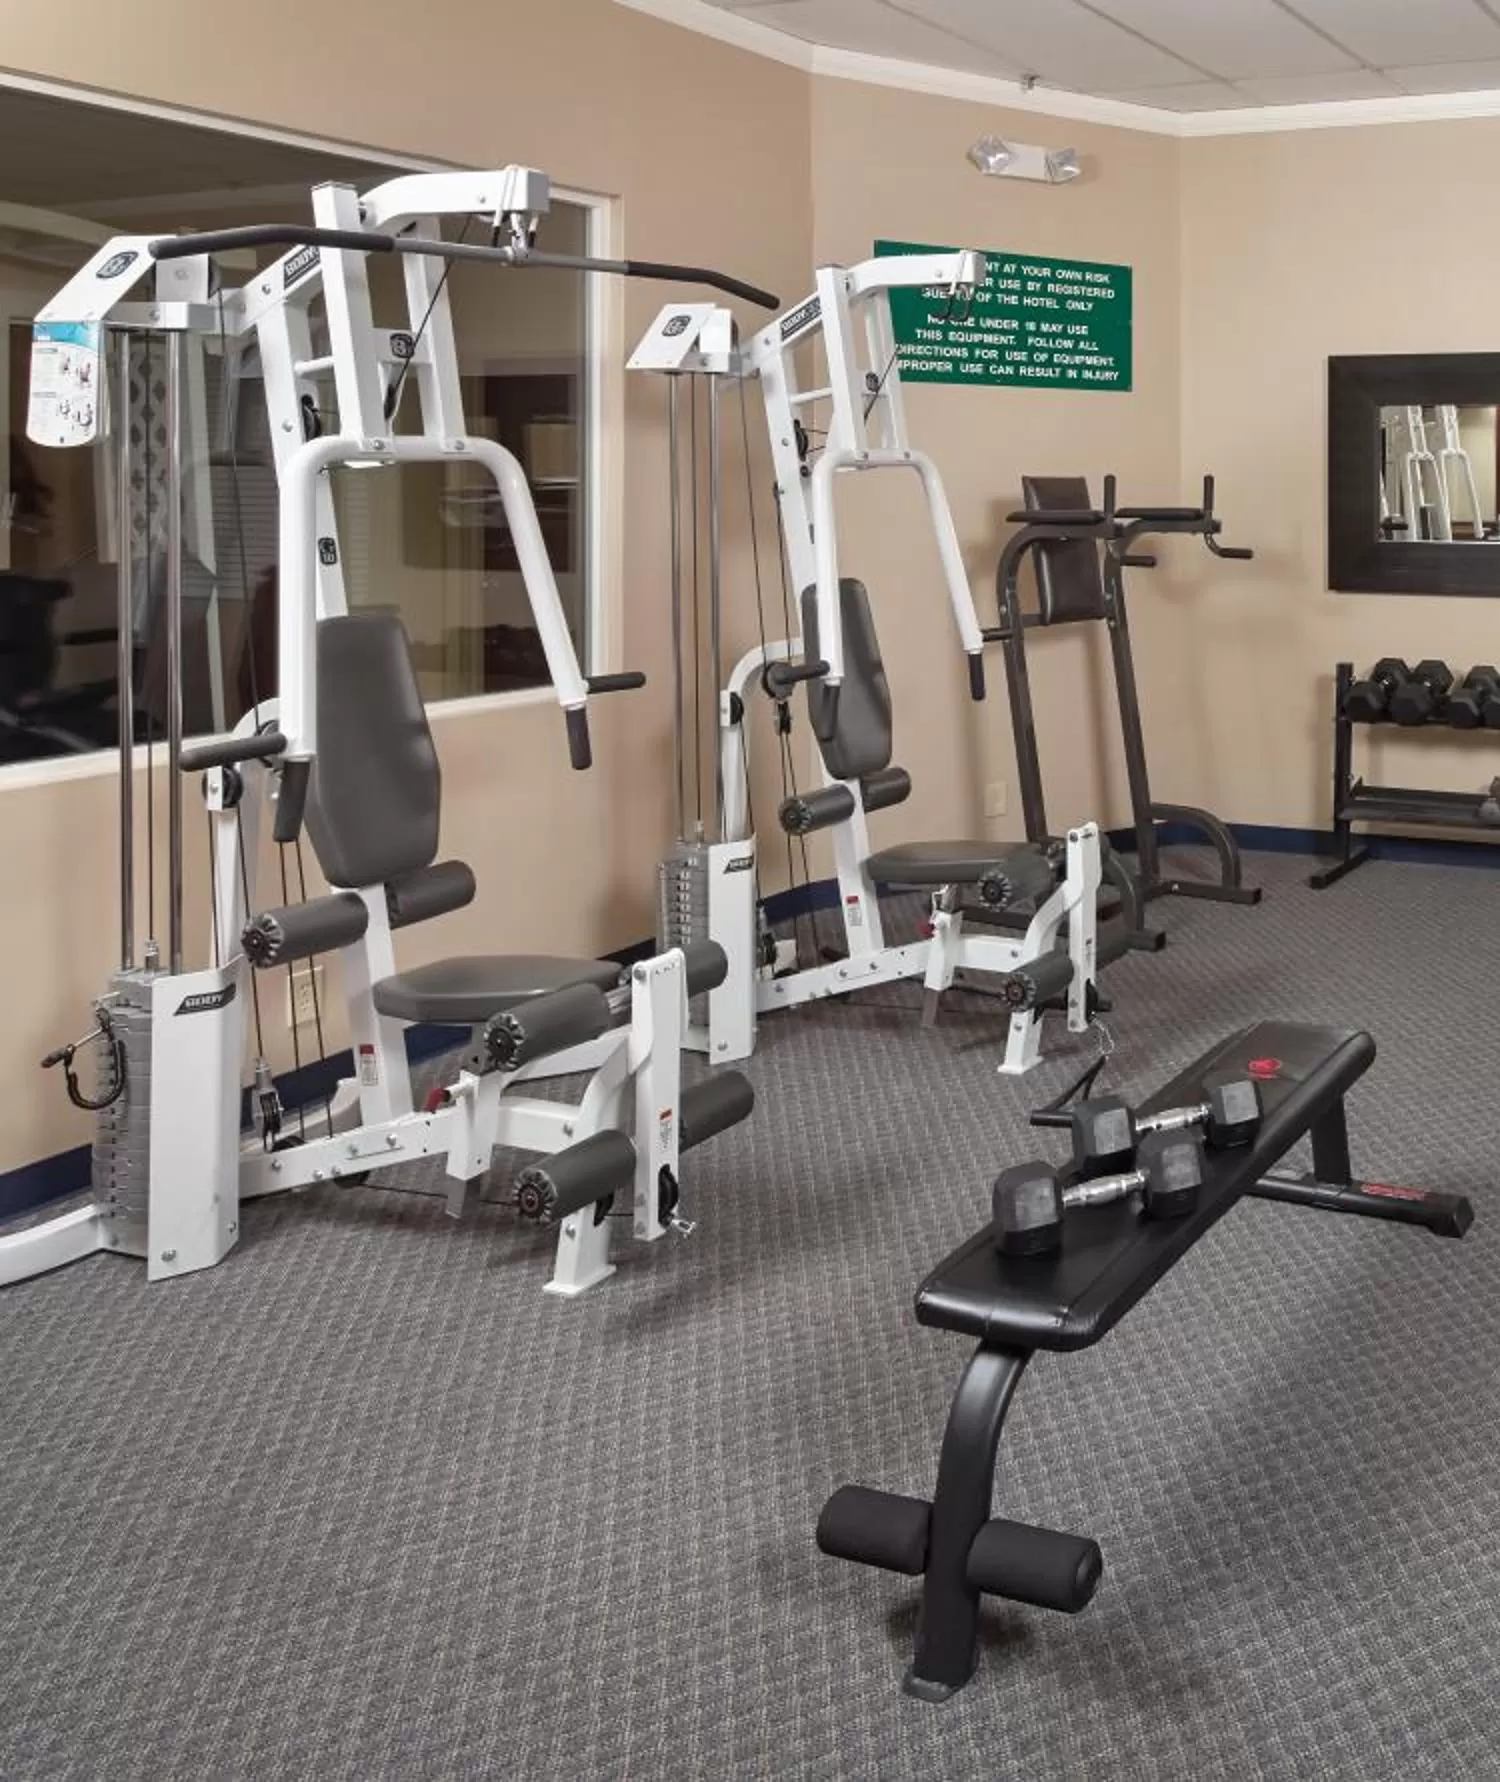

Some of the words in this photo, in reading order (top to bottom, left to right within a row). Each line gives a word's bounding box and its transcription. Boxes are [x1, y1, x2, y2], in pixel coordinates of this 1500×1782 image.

[1003, 263, 1017, 274] AT
[1021, 265, 1051, 277] YOUR
[1056, 269, 1082, 280] OWN
[1086, 271, 1110, 283] RISK
[999, 279, 1021, 290] USE
[1027, 281, 1041, 291] BY
[1047, 283, 1115, 299] REGISTERED
[975, 291, 993, 302] OF
[996, 293, 1019, 305] THE
[1023, 296, 1060, 309] HOTEL
[1065, 299, 1094, 311] ONLY
[979, 317, 1019, 330] UNDER
[1040, 322, 1064, 333] MAY
[1067, 325, 1089, 335] USE
[915, 328, 942, 340] THIS
[948, 331, 1017, 345] EQUIPMENT.
[1027, 336, 1075, 349] FOLLOW
[1078, 340, 1099, 351] ALL
[974, 348, 999, 360] FOR
[1005, 351, 1029, 361] USE
[1033, 352, 1049, 362] OF
[960, 363, 984, 374] USE
[989, 364, 1015, 375] CAN
[1020, 366, 1061, 378] RESULT
[1066, 369, 1077, 379] IN
[1082, 370, 1119, 381] INJURY
